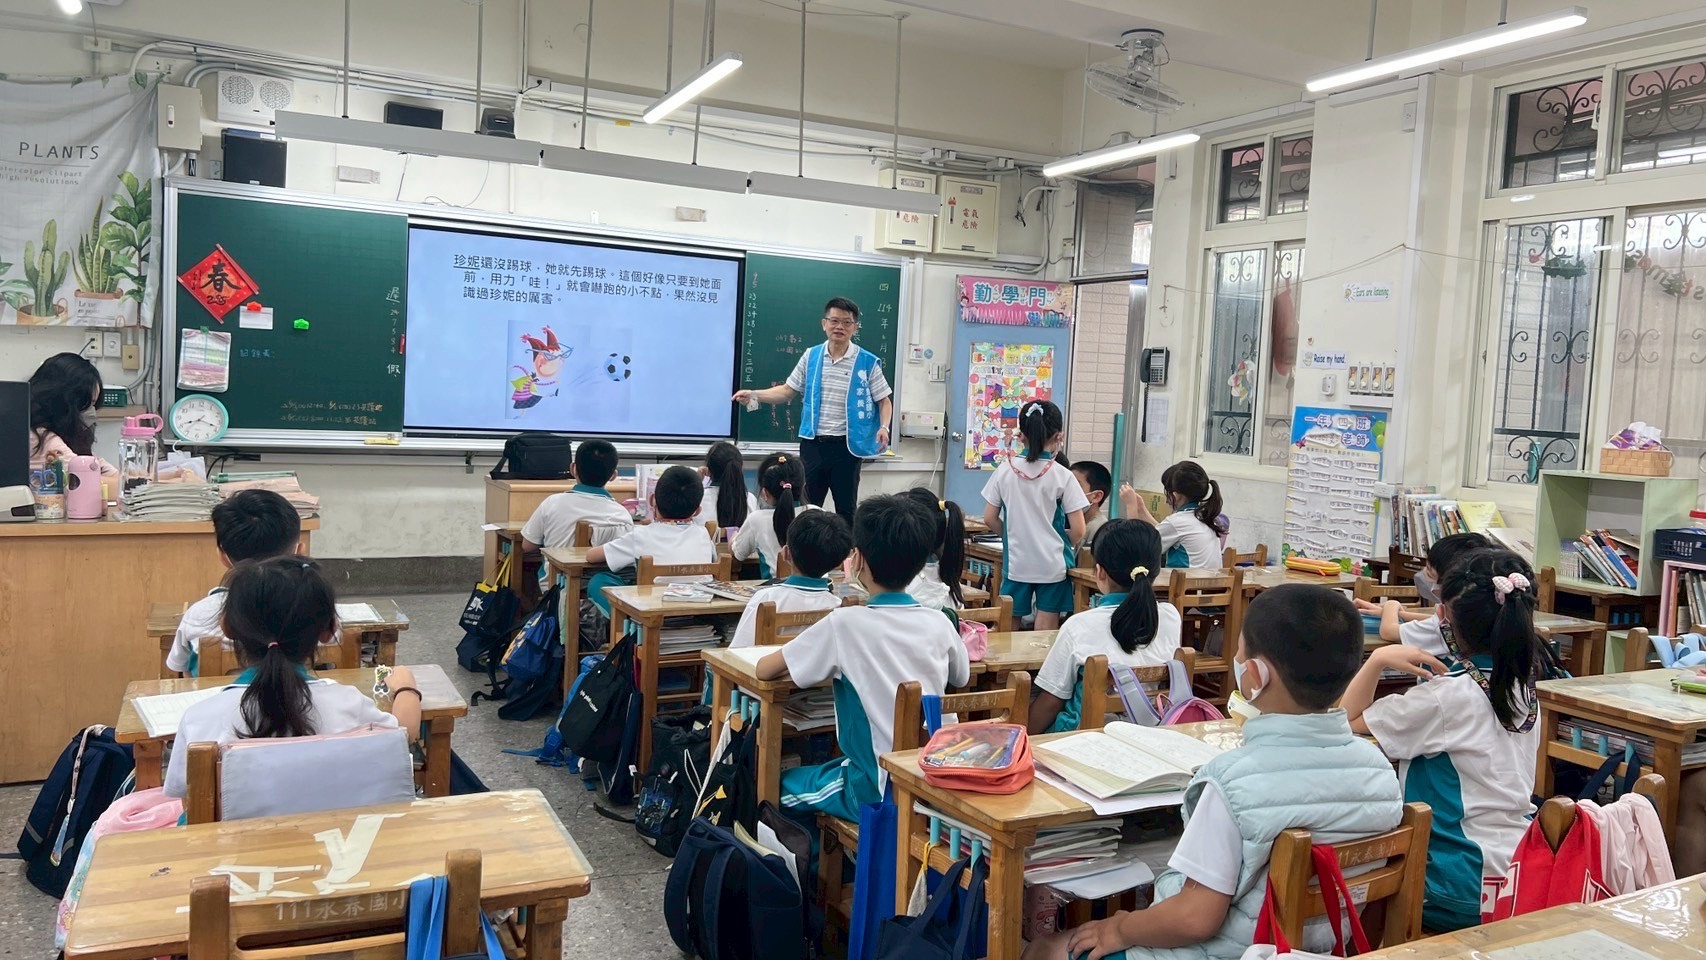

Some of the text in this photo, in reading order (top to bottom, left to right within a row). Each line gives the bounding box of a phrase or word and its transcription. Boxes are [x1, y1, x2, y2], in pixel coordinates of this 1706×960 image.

[19, 141, 100, 160] PLANTS
[48, 170, 83, 178] clipart
[25, 177, 79, 186] resolutions
[961, 220, 978, 230] 危險
[199, 258, 242, 293] 春
[973, 283, 1047, 307] 勤學門
[1314, 353, 1325, 363] Raise
[1326, 356, 1334, 366] my
[1341, 432, 1370, 447] 老師
